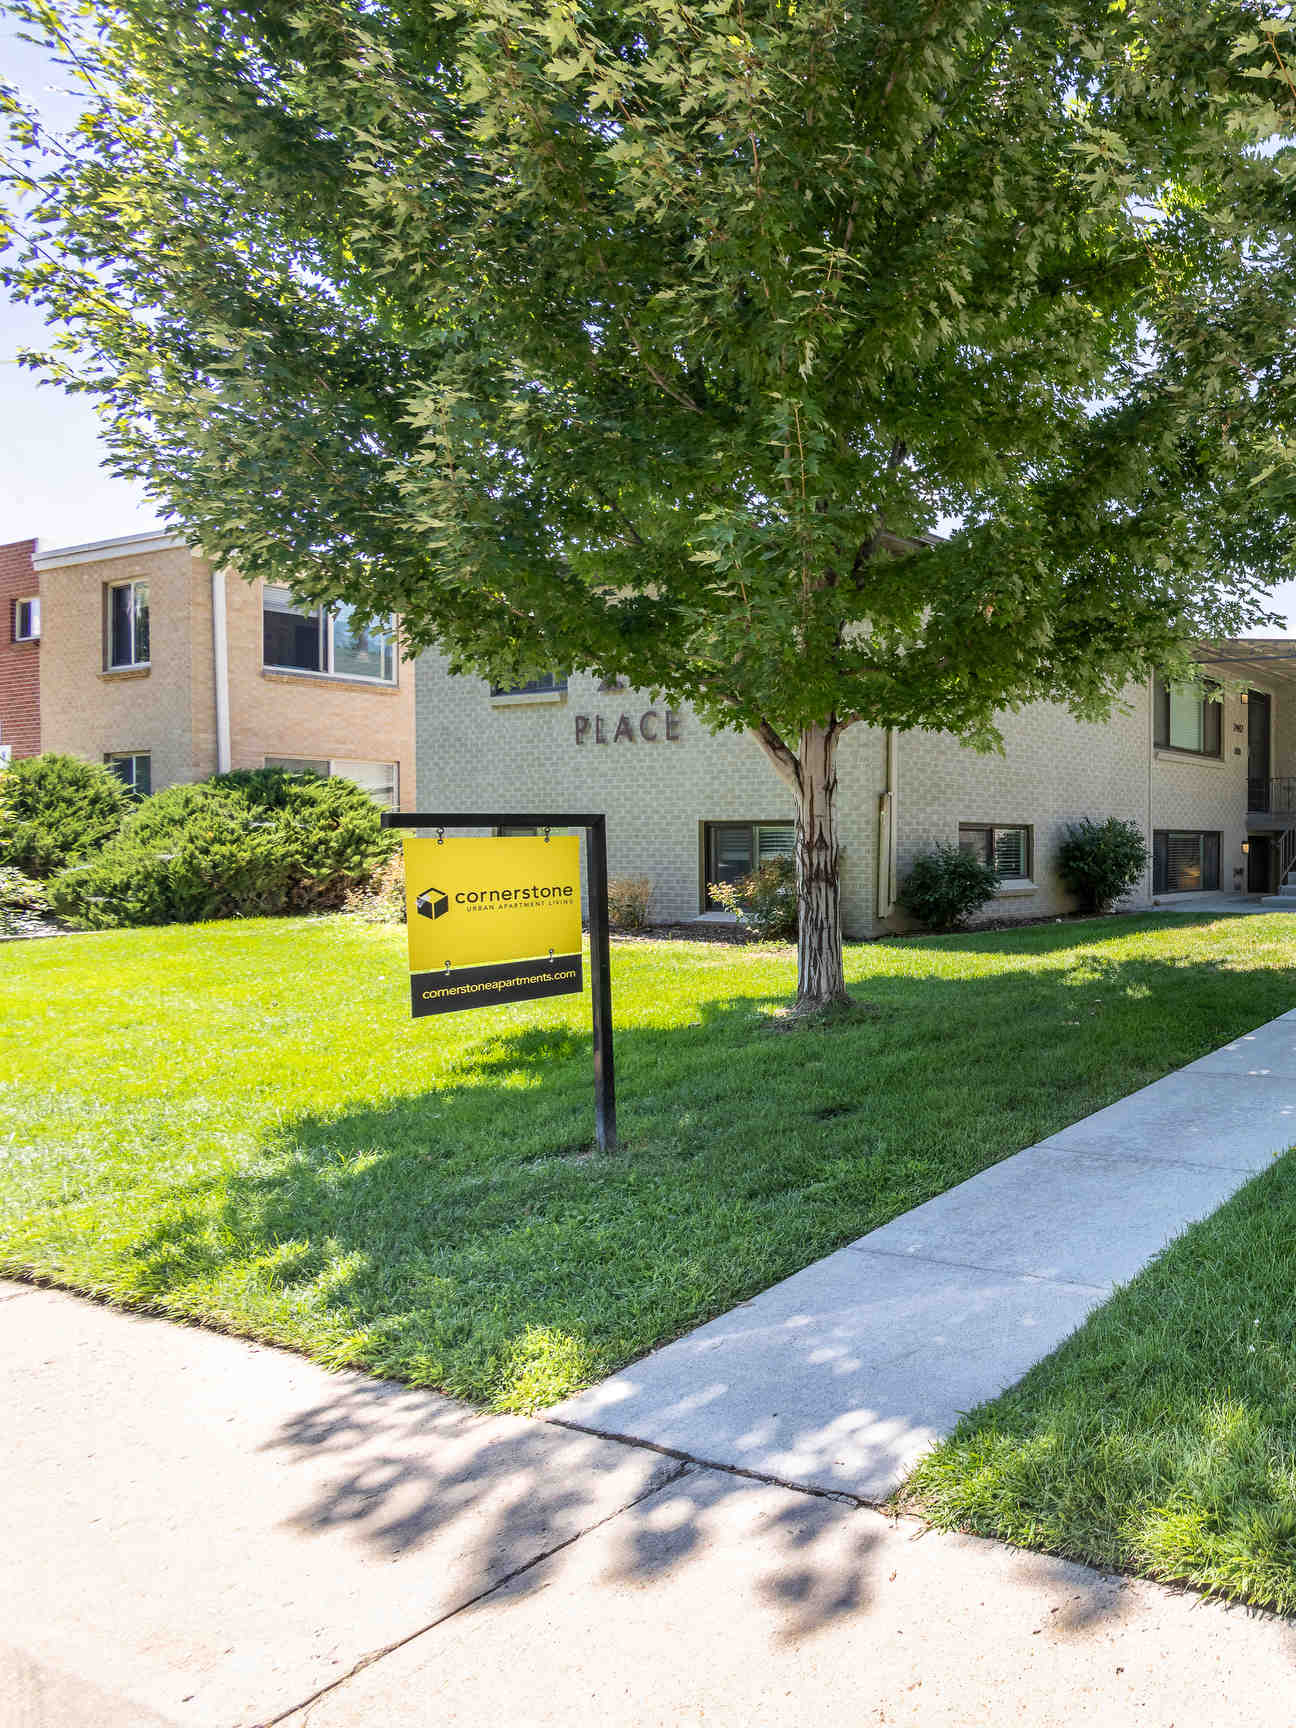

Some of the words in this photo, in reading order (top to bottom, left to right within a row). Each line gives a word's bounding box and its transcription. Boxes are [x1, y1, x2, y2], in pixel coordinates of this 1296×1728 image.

[575, 711, 681, 745] PLACE
[455, 886, 573, 904] cornerstone
[466, 904, 495, 912] URBAN
[498, 901, 545, 910] APARTMENT
[548, 898, 574, 906] LIVING
[422, 969, 577, 1000] cornerstoneapartments.com
